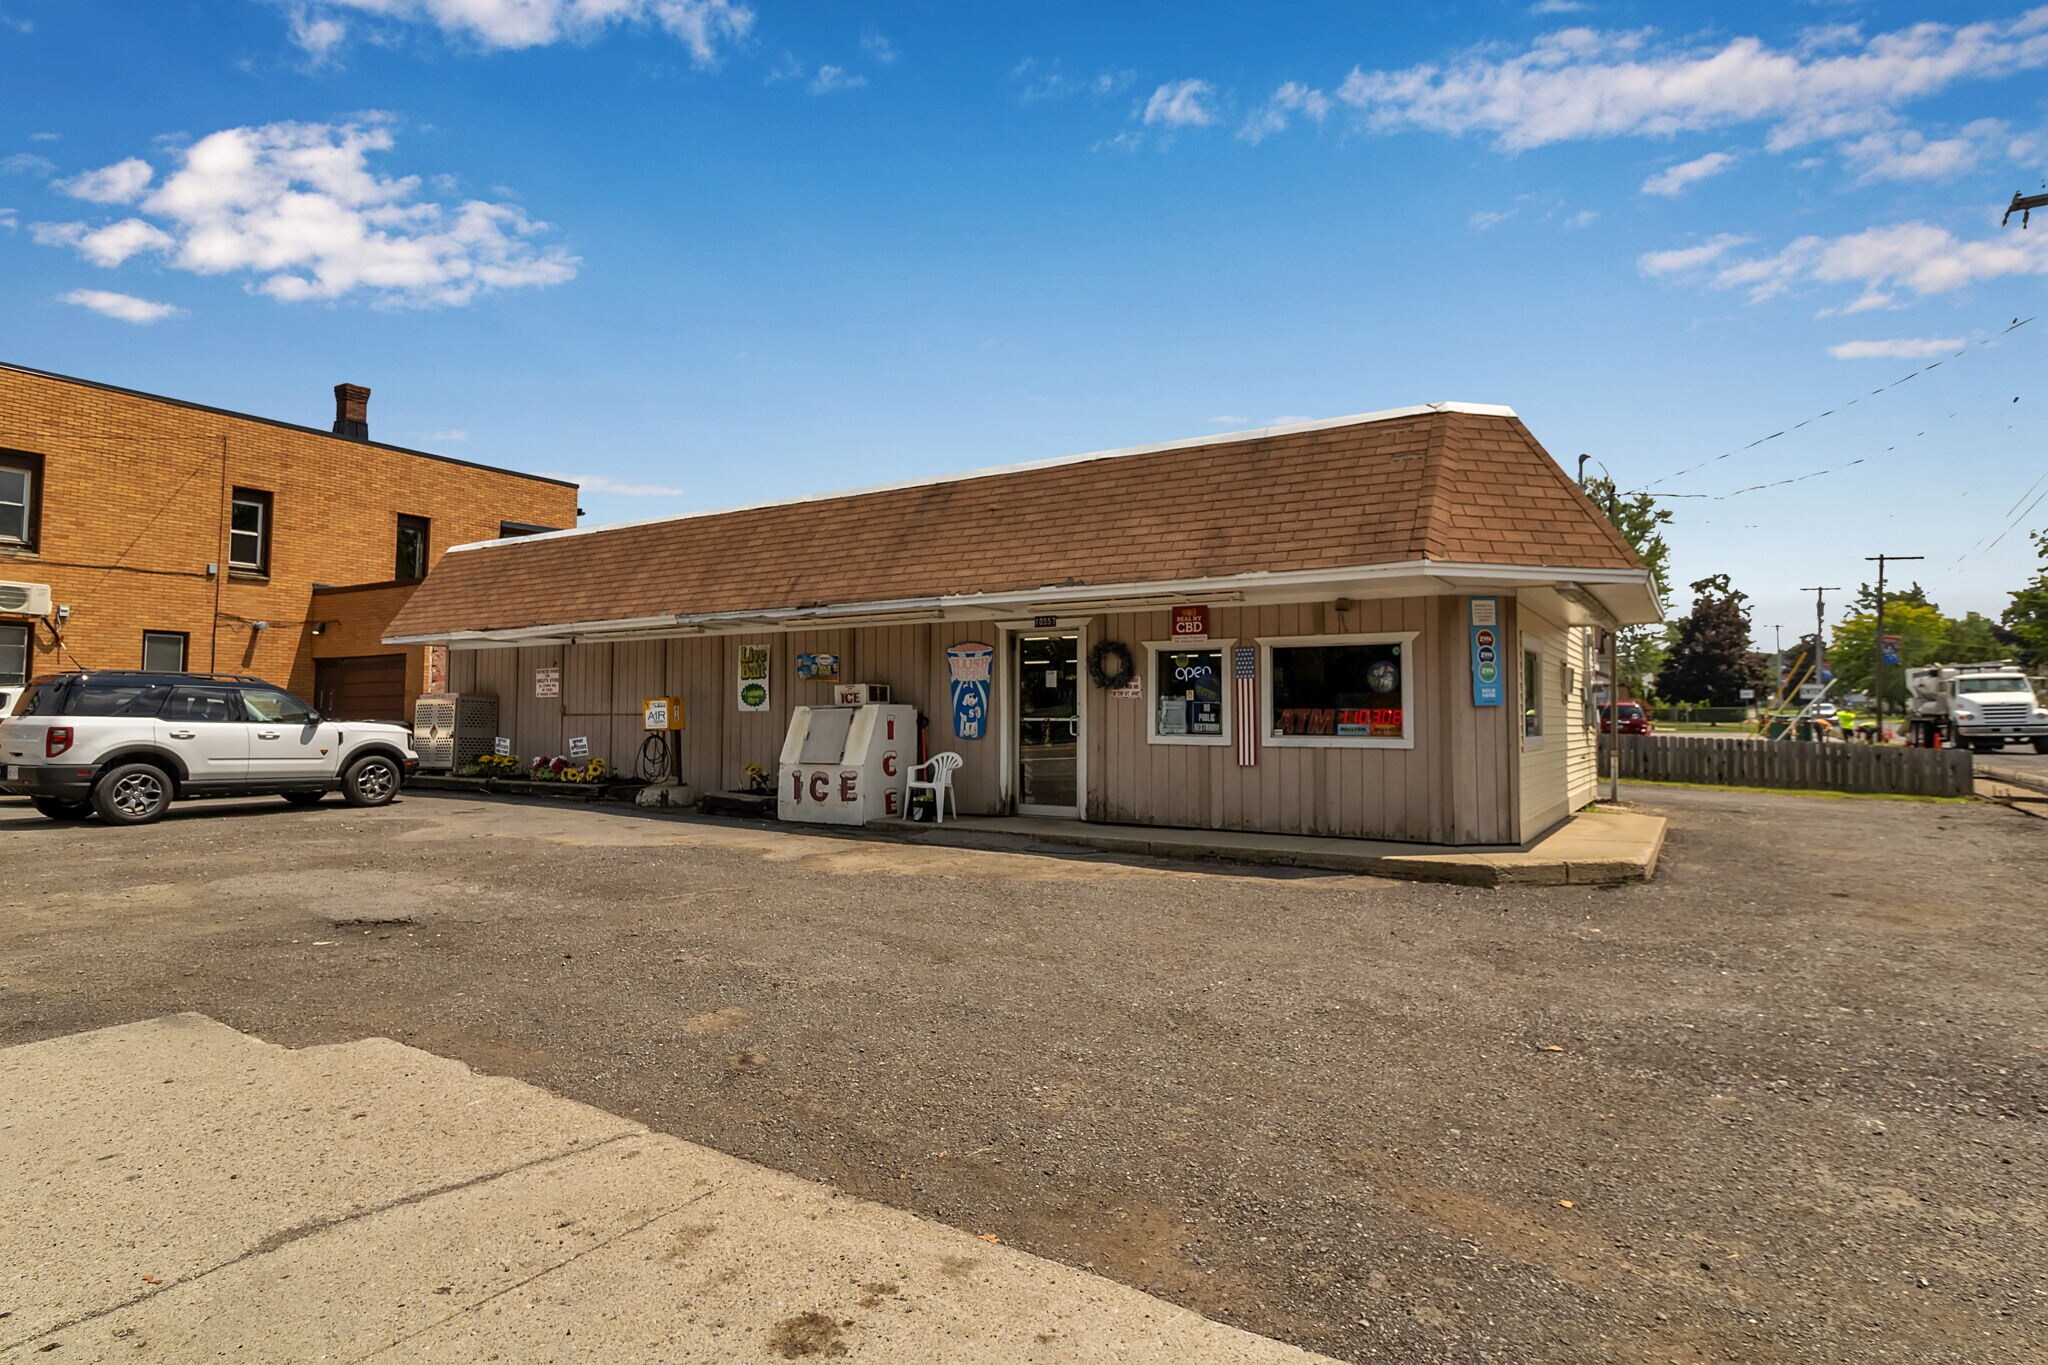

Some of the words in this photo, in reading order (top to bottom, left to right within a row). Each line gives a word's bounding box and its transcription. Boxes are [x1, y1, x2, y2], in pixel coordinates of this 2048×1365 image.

[1176, 621, 1203, 633] CBD
[740, 646, 768, 663] Live
[740, 662, 767, 680] Bait
[951, 658, 989, 669] SLUSH
[1175, 666, 1212, 682] open
[841, 692, 860, 704] ICE
[647, 710, 666, 720] AIR
[968, 710, 975, 718] S
[1277, 708, 1336, 734] ATM
[882, 714, 898, 816] ICE
[791, 769, 859, 804] ICE
